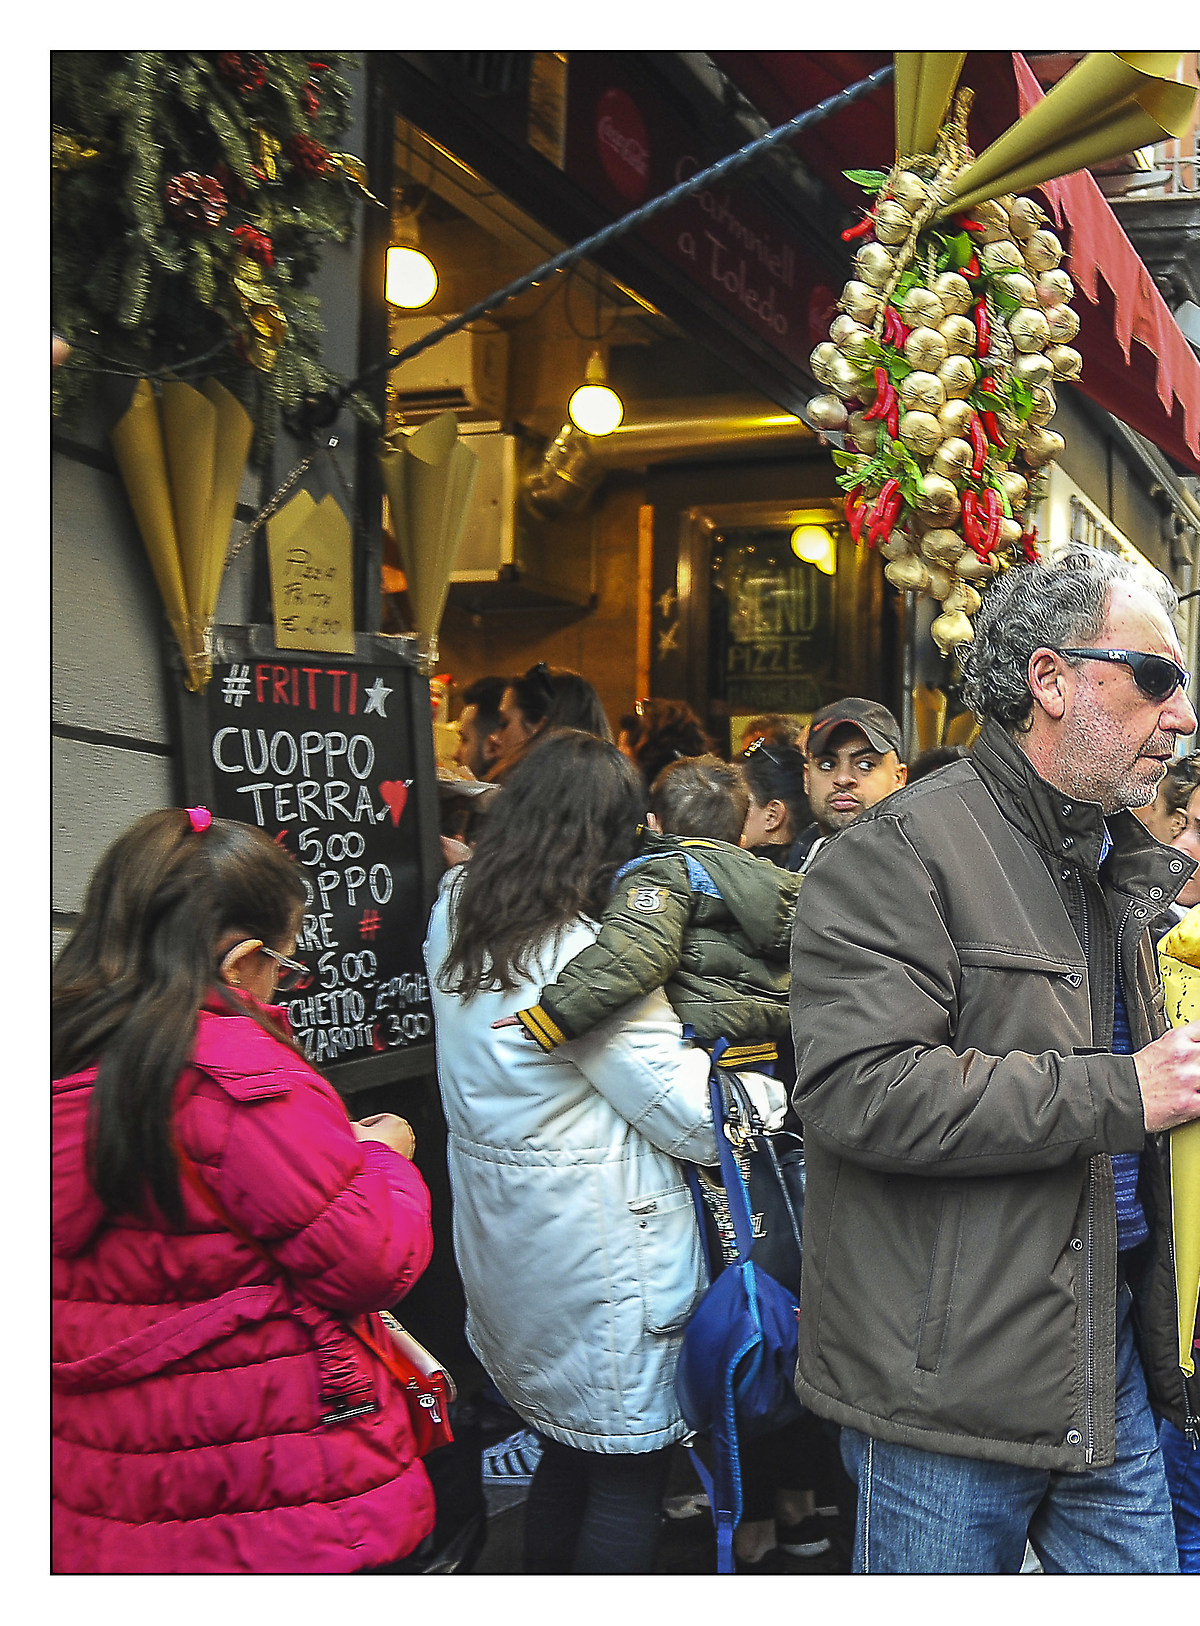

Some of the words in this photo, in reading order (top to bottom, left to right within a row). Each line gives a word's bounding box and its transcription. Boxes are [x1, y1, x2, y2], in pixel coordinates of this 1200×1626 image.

[704, 228, 788, 335] Toledo
[728, 641, 804, 673] PIZZE
[212, 727, 375, 780] CUOPPO
[236, 780, 377, 826] TERRA
[298, 827, 366, 868] 5.00
[317, 950, 378, 989] 5.00
[279, 987, 365, 1028] CHETTO
